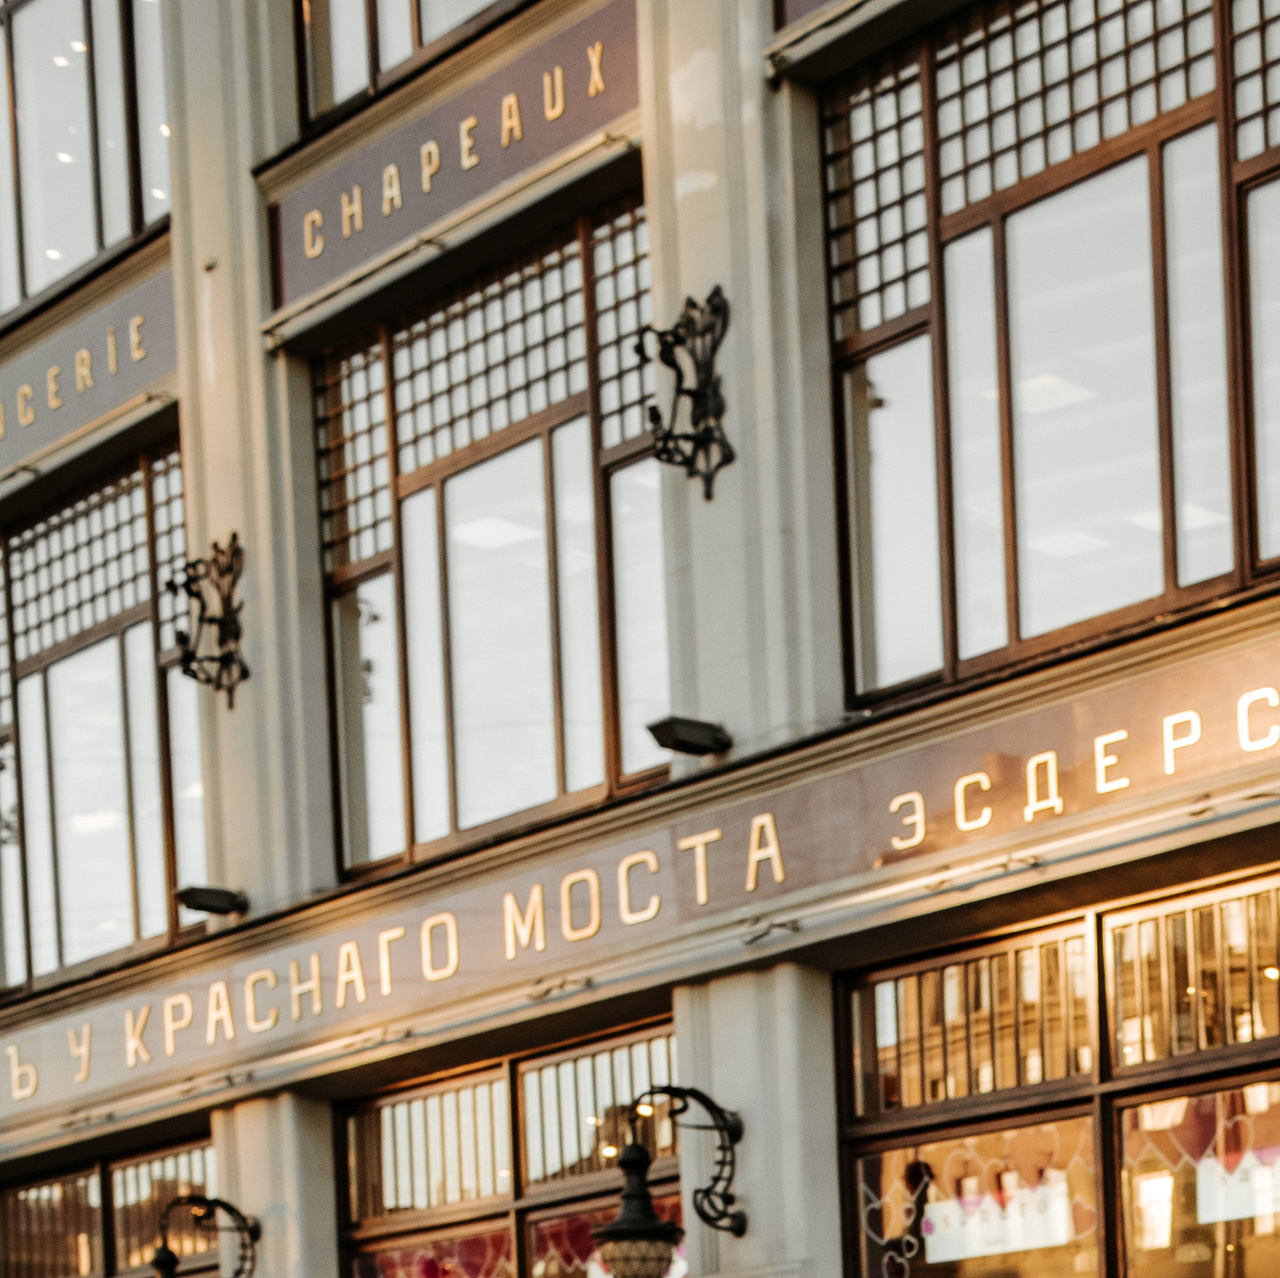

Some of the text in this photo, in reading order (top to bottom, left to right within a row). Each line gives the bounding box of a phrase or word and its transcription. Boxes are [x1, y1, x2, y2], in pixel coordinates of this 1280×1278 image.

[303, 41, 607, 259] CHAPEAUX
[0, 315, 147, 439] CERIE
[125, 911, 460, 1069] КРАСНАГО
[503, 812, 787, 960] МОСТА
